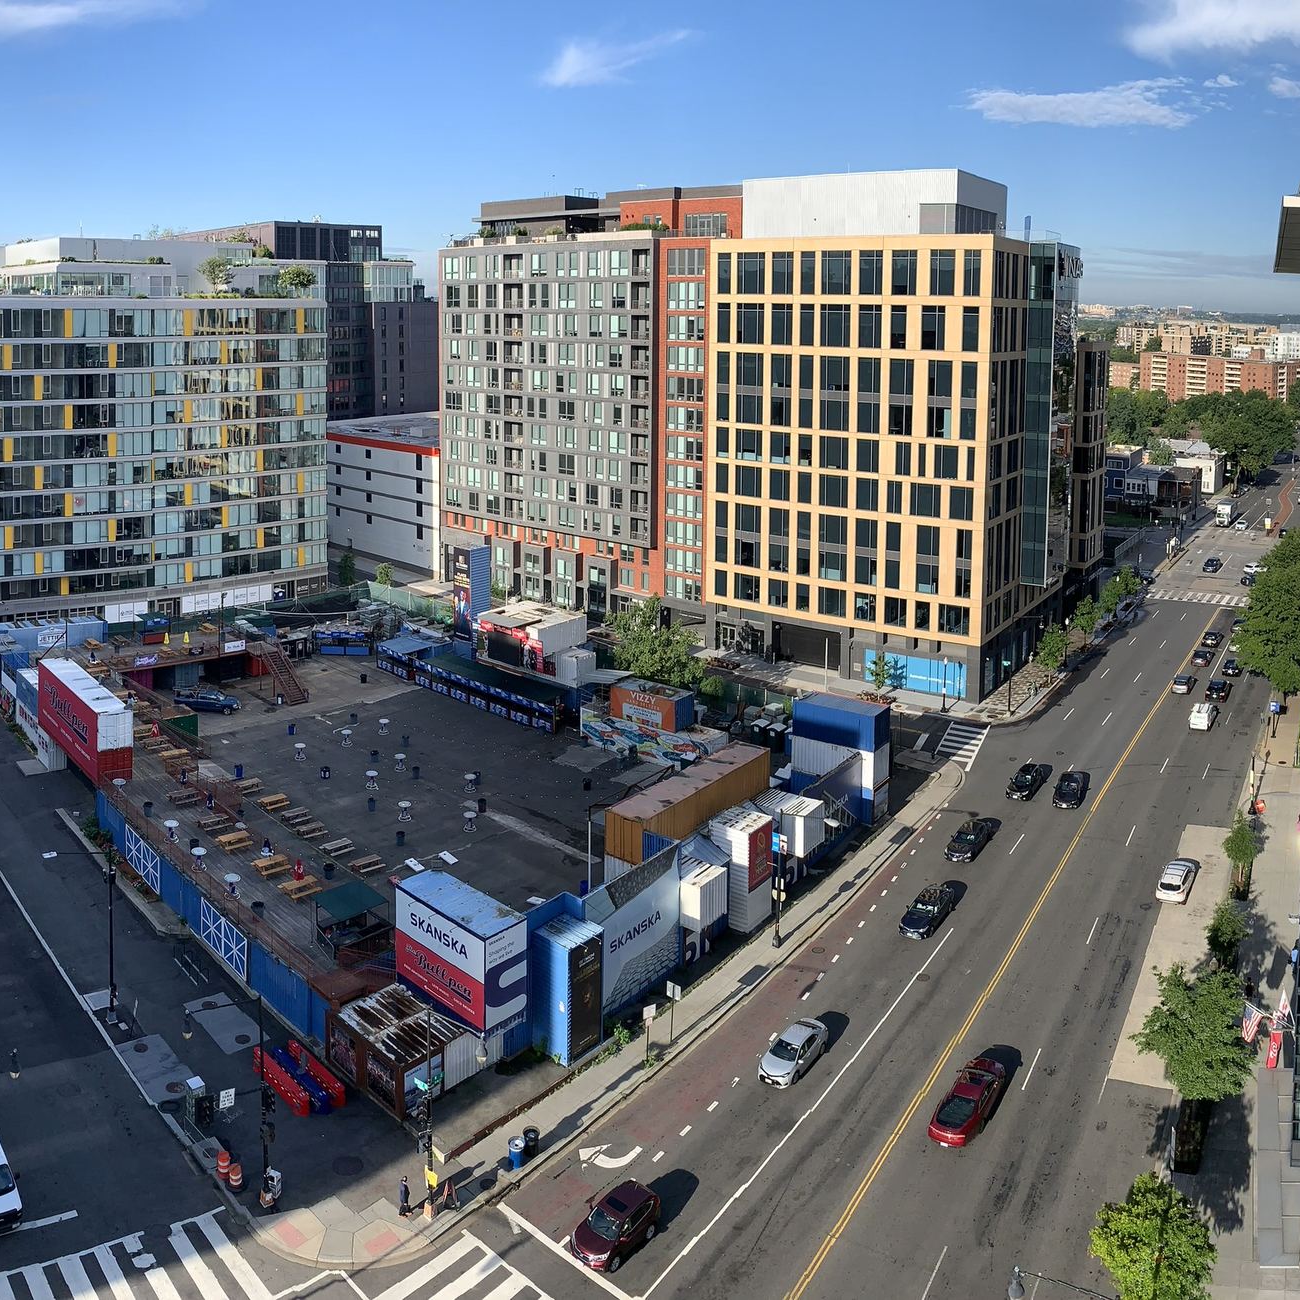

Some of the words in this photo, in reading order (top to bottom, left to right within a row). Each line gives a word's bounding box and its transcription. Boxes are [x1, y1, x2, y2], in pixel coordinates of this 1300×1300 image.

[630, 691, 656, 704] VIZZY
[410, 912, 468, 959] SKANSKA
[610, 910, 661, 954] SKANSKA
